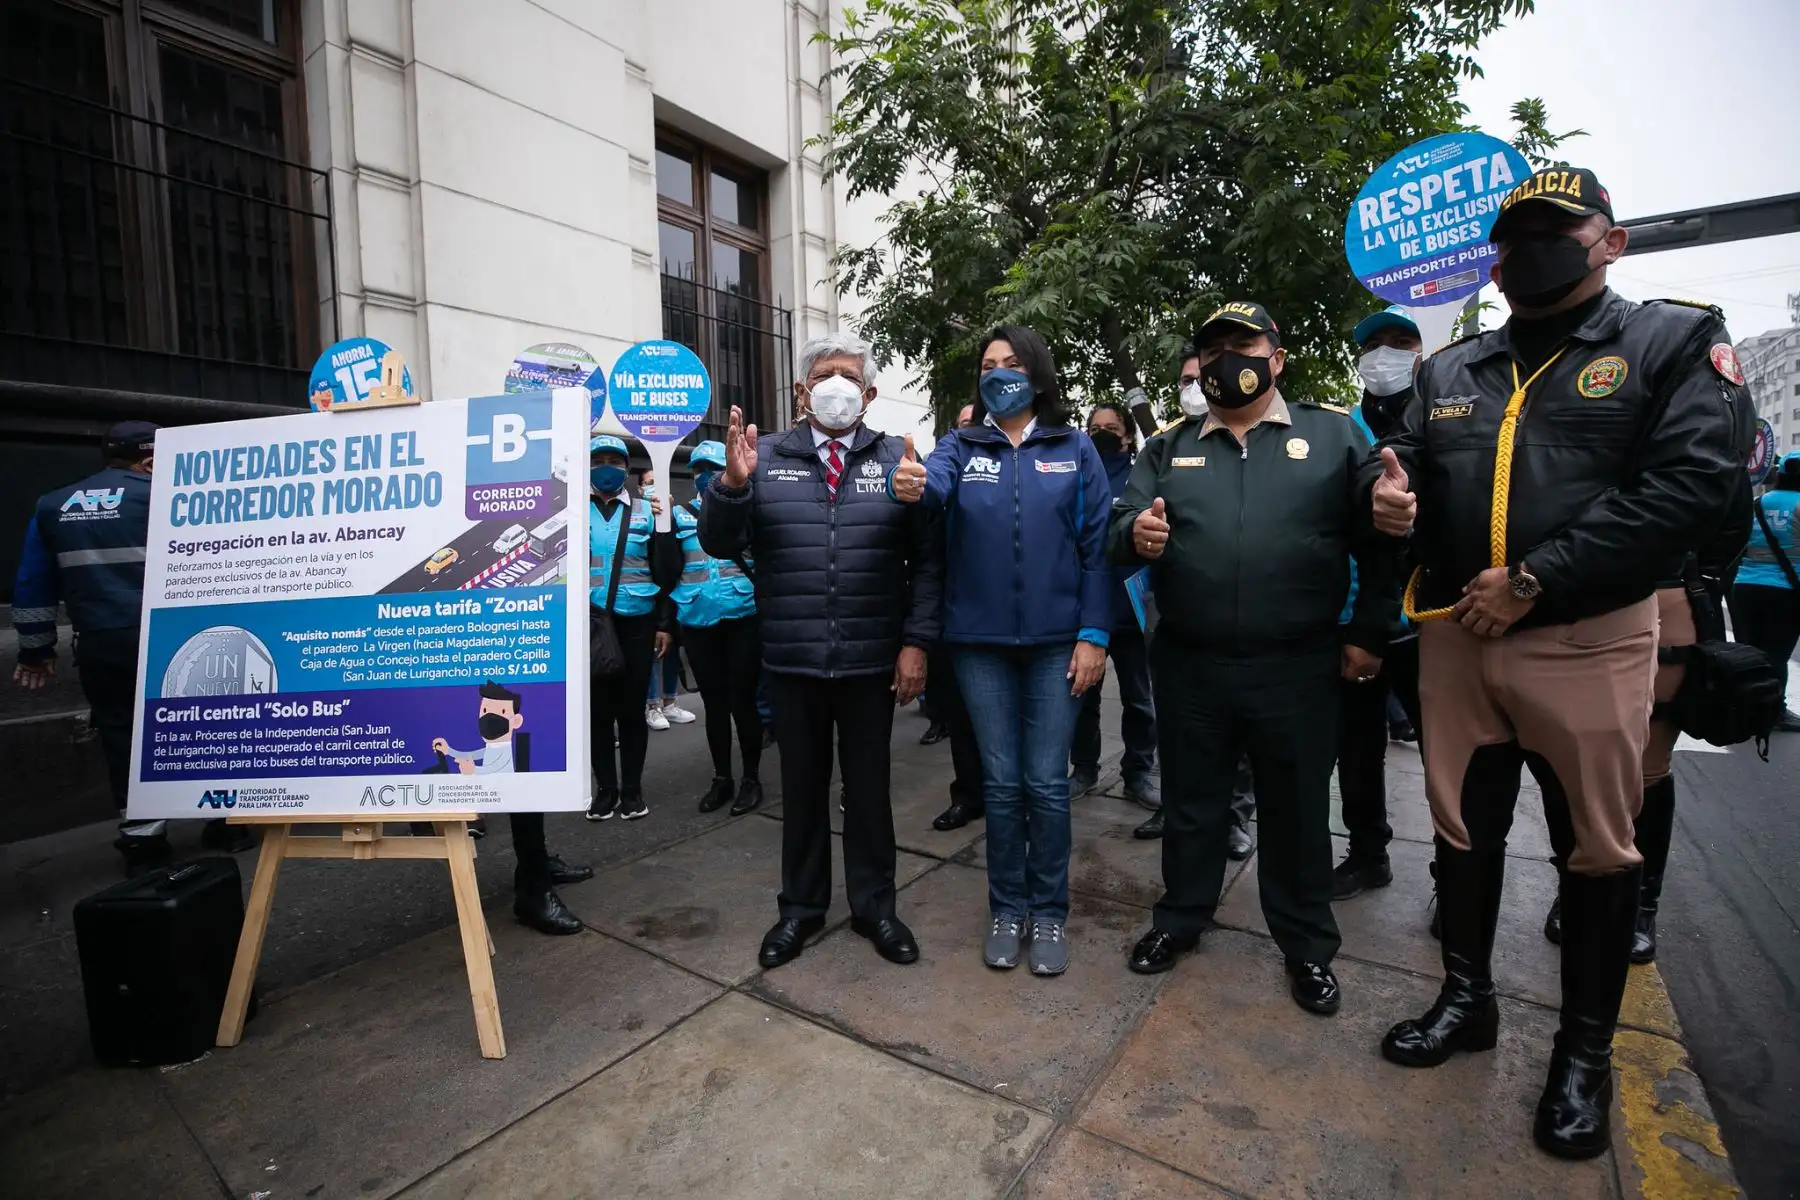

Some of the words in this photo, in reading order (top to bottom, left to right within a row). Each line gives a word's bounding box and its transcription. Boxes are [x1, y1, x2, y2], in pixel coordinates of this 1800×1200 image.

[1358, 151, 1515, 232] RESPETA
[1363, 231, 1386, 252] LA
[1388, 218, 1418, 242] VÍA
[1421, 189, 1513, 233] EXCLUSIV
[1400, 238, 1422, 260] DE
[1425, 220, 1482, 253] BUSES
[1367, 255, 1457, 289] TRANSPORTE
[1458, 244, 1497, 264] PÚBL
[331, 343, 374, 368] AHORRA
[614, 370, 636, 388] VÍA
[638, 373, 704, 389] EXCLUSIVA
[630, 391, 647, 407] DE
[649, 391, 689, 407] BUSES
[618, 413, 667, 421] TRANSPORTE
[669, 412, 702, 422] PÚBLICO
[492, 413, 527, 463] B
[173, 438, 337, 487] NOVEDADES
[344, 434, 382, 472] EN
[390, 430, 425, 468] EL
[964, 456, 1001, 474] ATU
[472, 485, 543, 501] CORREDOR
[856, 483, 886, 493] LIM
[60, 487, 125, 512] ATU
[170, 482, 315, 528] CORREDOR
[322, 471, 443, 515] MORADO
[479, 498, 536, 513] MORADO
[168, 534, 264, 556] Segregación
[268, 534, 287, 547] en
[291, 531, 305, 545] la
[309, 532, 331, 544] av.
[335, 526, 406, 542] Abancay
[167, 560, 222, 573] Reforzamos
[224, 560, 233, 569] la
[235, 554, 293, 569] segregación
[295, 555, 308, 564] en
[310, 553, 318, 563] la
[321, 551, 334, 562] vía
[336, 553, 342, 564] y
[344, 552, 357, 560] en
[360, 550, 374, 559] los
[165, 575, 212, 588] paraderos
[214, 571, 263, 583] exclusivos
[264, 570, 277, 580] de
[279, 569, 287, 578] la
[305, 566, 347, 577] Abancay
[164, 589, 195, 600] dando
[196, 586, 250, 599] preferencia
[252, 584, 260, 594] al
[263, 581, 312, 594] transporte
[314, 579, 354, 592] público.
[377, 601, 431, 619] Nueva
[435, 598, 482, 616] tarifa
[373, 626, 404, 637] desde
[406, 625, 416, 636] el
[418, 624, 465, 637] paradero
[467, 620, 520, 634] Bolognesi
[521, 619, 551, 630] hasta
[302, 645, 311, 655] el
[314, 643, 359, 657] paradero
[363, 642, 375, 652] La
[377, 640, 411, 653] Virgen
[413, 639, 444, 650] (hacia
[446, 635, 507, 650] Magdalena)
[509, 637, 516, 648] y
[518, 634, 551, 645] desde
[205, 654, 239, 679] UN
[300, 659, 322, 671] Caja
[324, 657, 337, 668] de
[339, 657, 365, 669] Agua
[367, 658, 375, 667] o
[376, 655, 420, 667] Concejo
[421, 654, 449, 664] hasta
[451, 652, 461, 663] el
[463, 650, 511, 664] paradero
[514, 648, 551, 661] Capilla
[343, 671, 364, 682] (San
[366, 670, 392, 681] Juan
[394, 669, 407, 679] de
[410, 666, 472, 680] Lurigancho)
[473, 668, 480, 676] a
[482, 665, 505, 676] solo
[507, 664, 520, 675] S/
[155, 705, 200, 723] Carril
[203, 703, 261, 721] central
[155, 731, 167, 743] En
[169, 731, 178, 742] la
[179, 732, 193, 742] av.
[195, 729, 238, 741] Próceres
[239, 729, 252, 739] de
[254, 728, 263, 739] la
[265, 725, 339, 740] Independencia
[341, 724, 363, 737] (San
[365, 724, 391, 735] Juan
[154, 746, 166, 757] de
[168, 743, 226, 758] Lurigancho)
[227, 745, 239, 754] se
[240, 743, 253, 754] ha
[255, 741, 312, 755] recuperado
[314, 740, 324, 751] el
[326, 740, 352, 751] carril
[353, 739, 389, 750] central
[391, 738, 405, 749] de
[153, 760, 182, 771] forma
[184, 758, 228, 770] exclusiva
[229, 759, 252, 770] para
[253, 757, 268, 768] los
[270, 756, 299, 768] buses
[300, 755, 316, 767] del
[318, 754, 372, 767] transporte
[373, 753, 416, 767] público.
[197, 789, 237, 809] ATU
[278, 787, 287, 795] DE
[360, 783, 434, 807] ACTU
